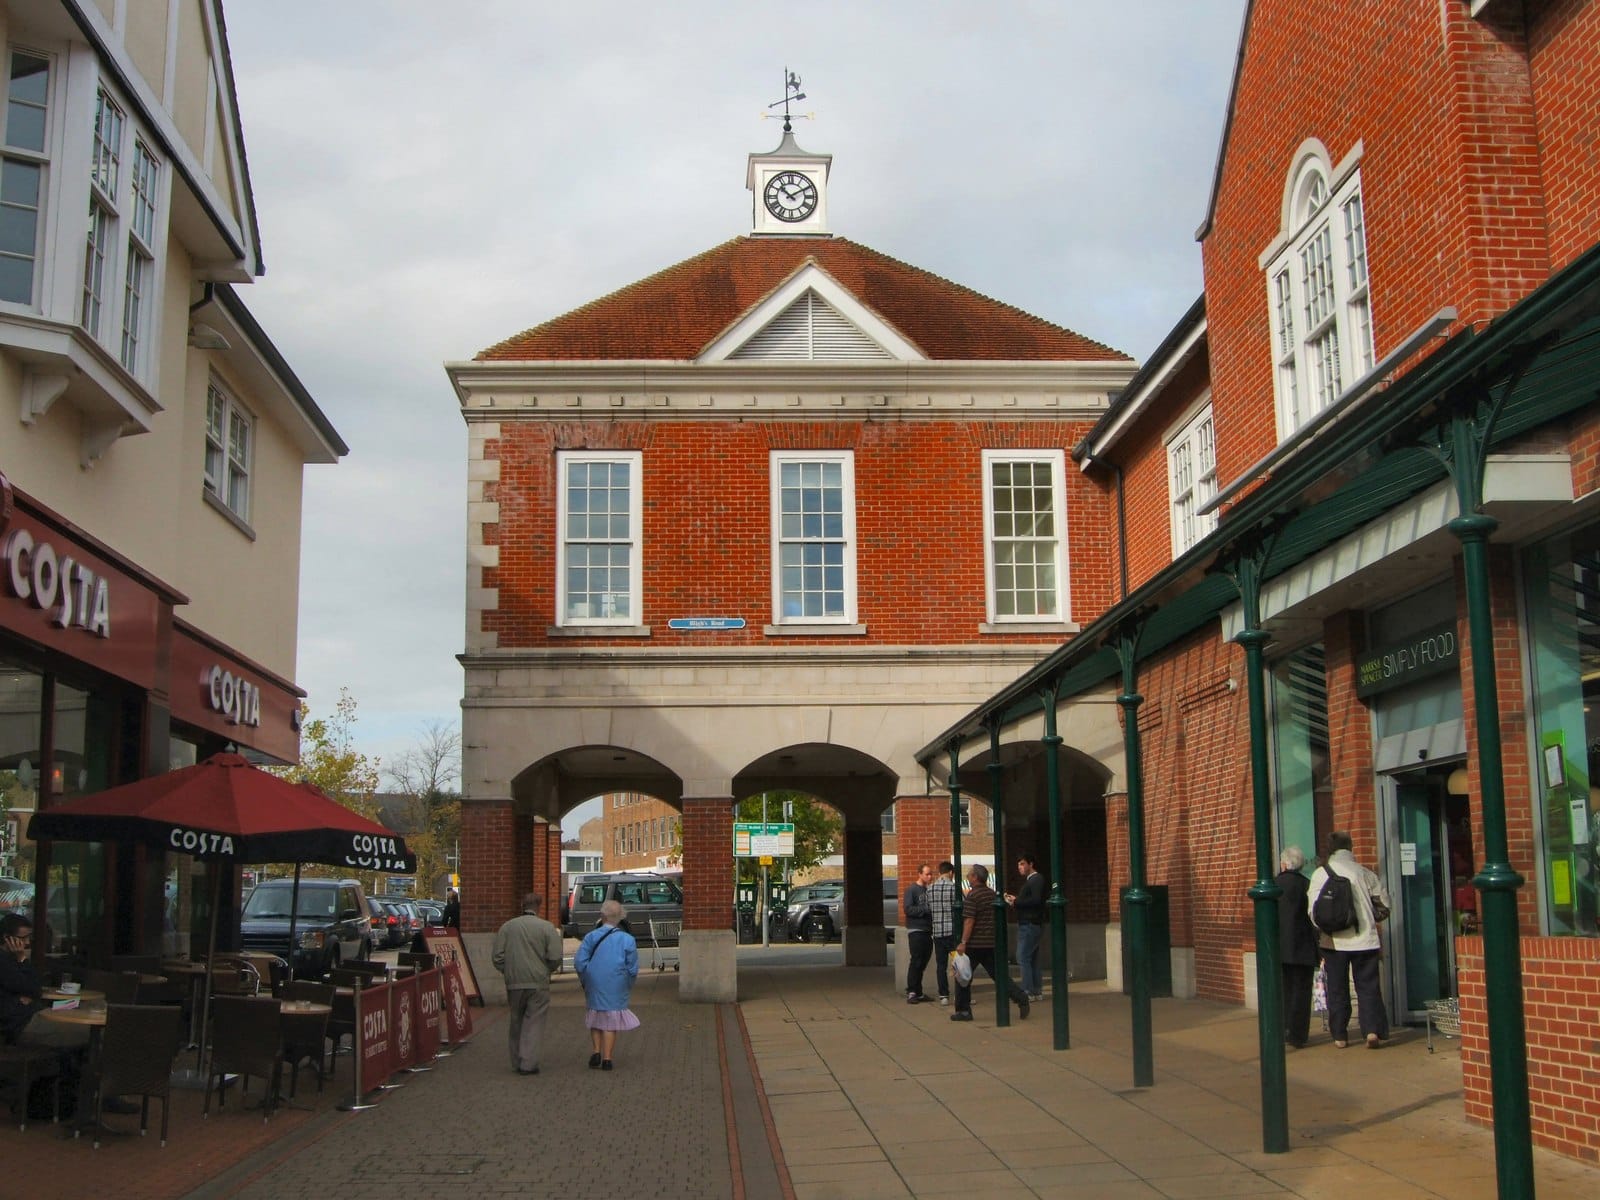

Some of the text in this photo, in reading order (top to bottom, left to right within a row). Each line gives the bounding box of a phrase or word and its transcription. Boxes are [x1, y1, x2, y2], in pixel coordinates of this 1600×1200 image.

[7, 529, 110, 639] COSTA
[1383, 632, 1454, 677] SIMPLY FOOD
[209, 664, 260, 728] COSTA
[170, 828, 234, 855] COSTA
[352, 834, 397, 856] COSTA
[364, 1009, 387, 1040] COSTA
